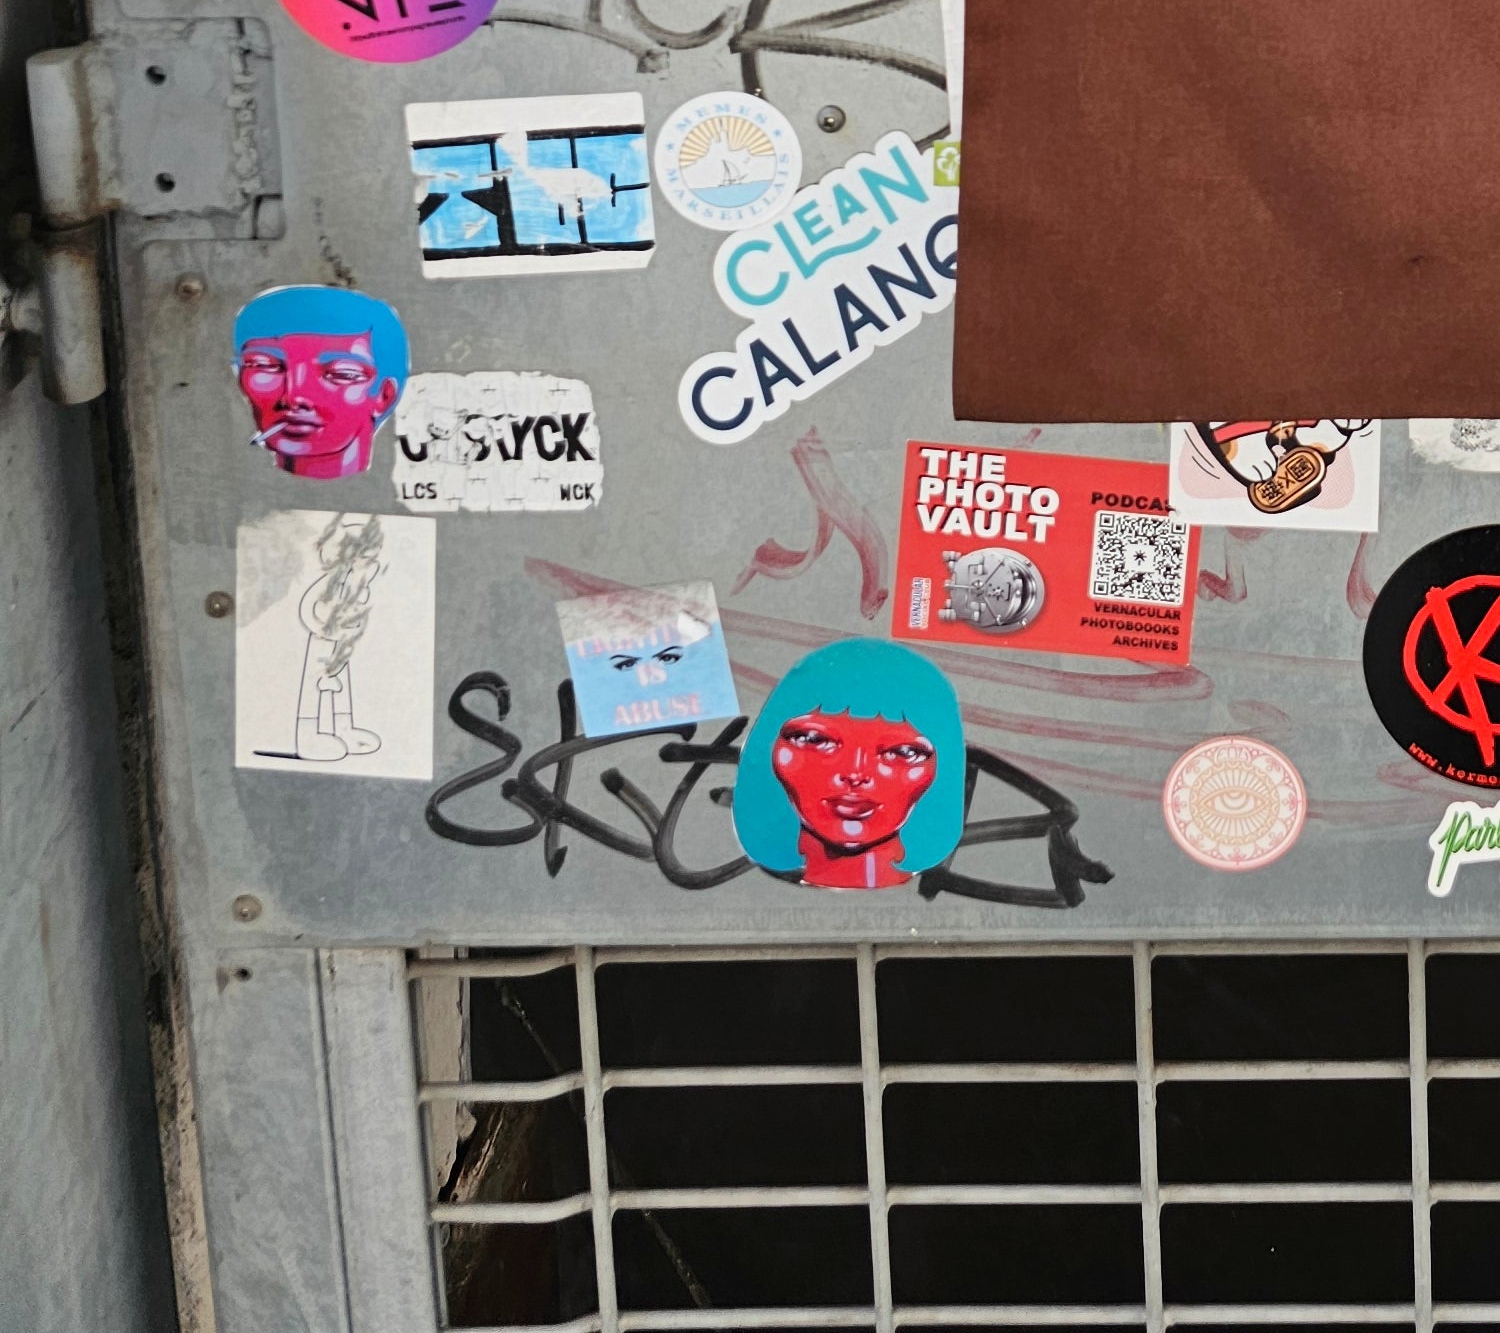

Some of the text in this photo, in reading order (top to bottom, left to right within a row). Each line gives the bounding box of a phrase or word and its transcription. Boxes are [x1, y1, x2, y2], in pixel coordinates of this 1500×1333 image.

[726, 145, 931, 307] CLEAN
[919, 447, 1008, 483] THE
[917, 475, 1061, 517] PHOTO
[915, 503, 1057, 543] VAULT
[1094, 601, 1182, 622] VERNACULAR
[1112, 635, 1179, 651] ARCHIVES
[636, 661, 669, 688] IS
[613, 692, 705, 727] ABUSE
